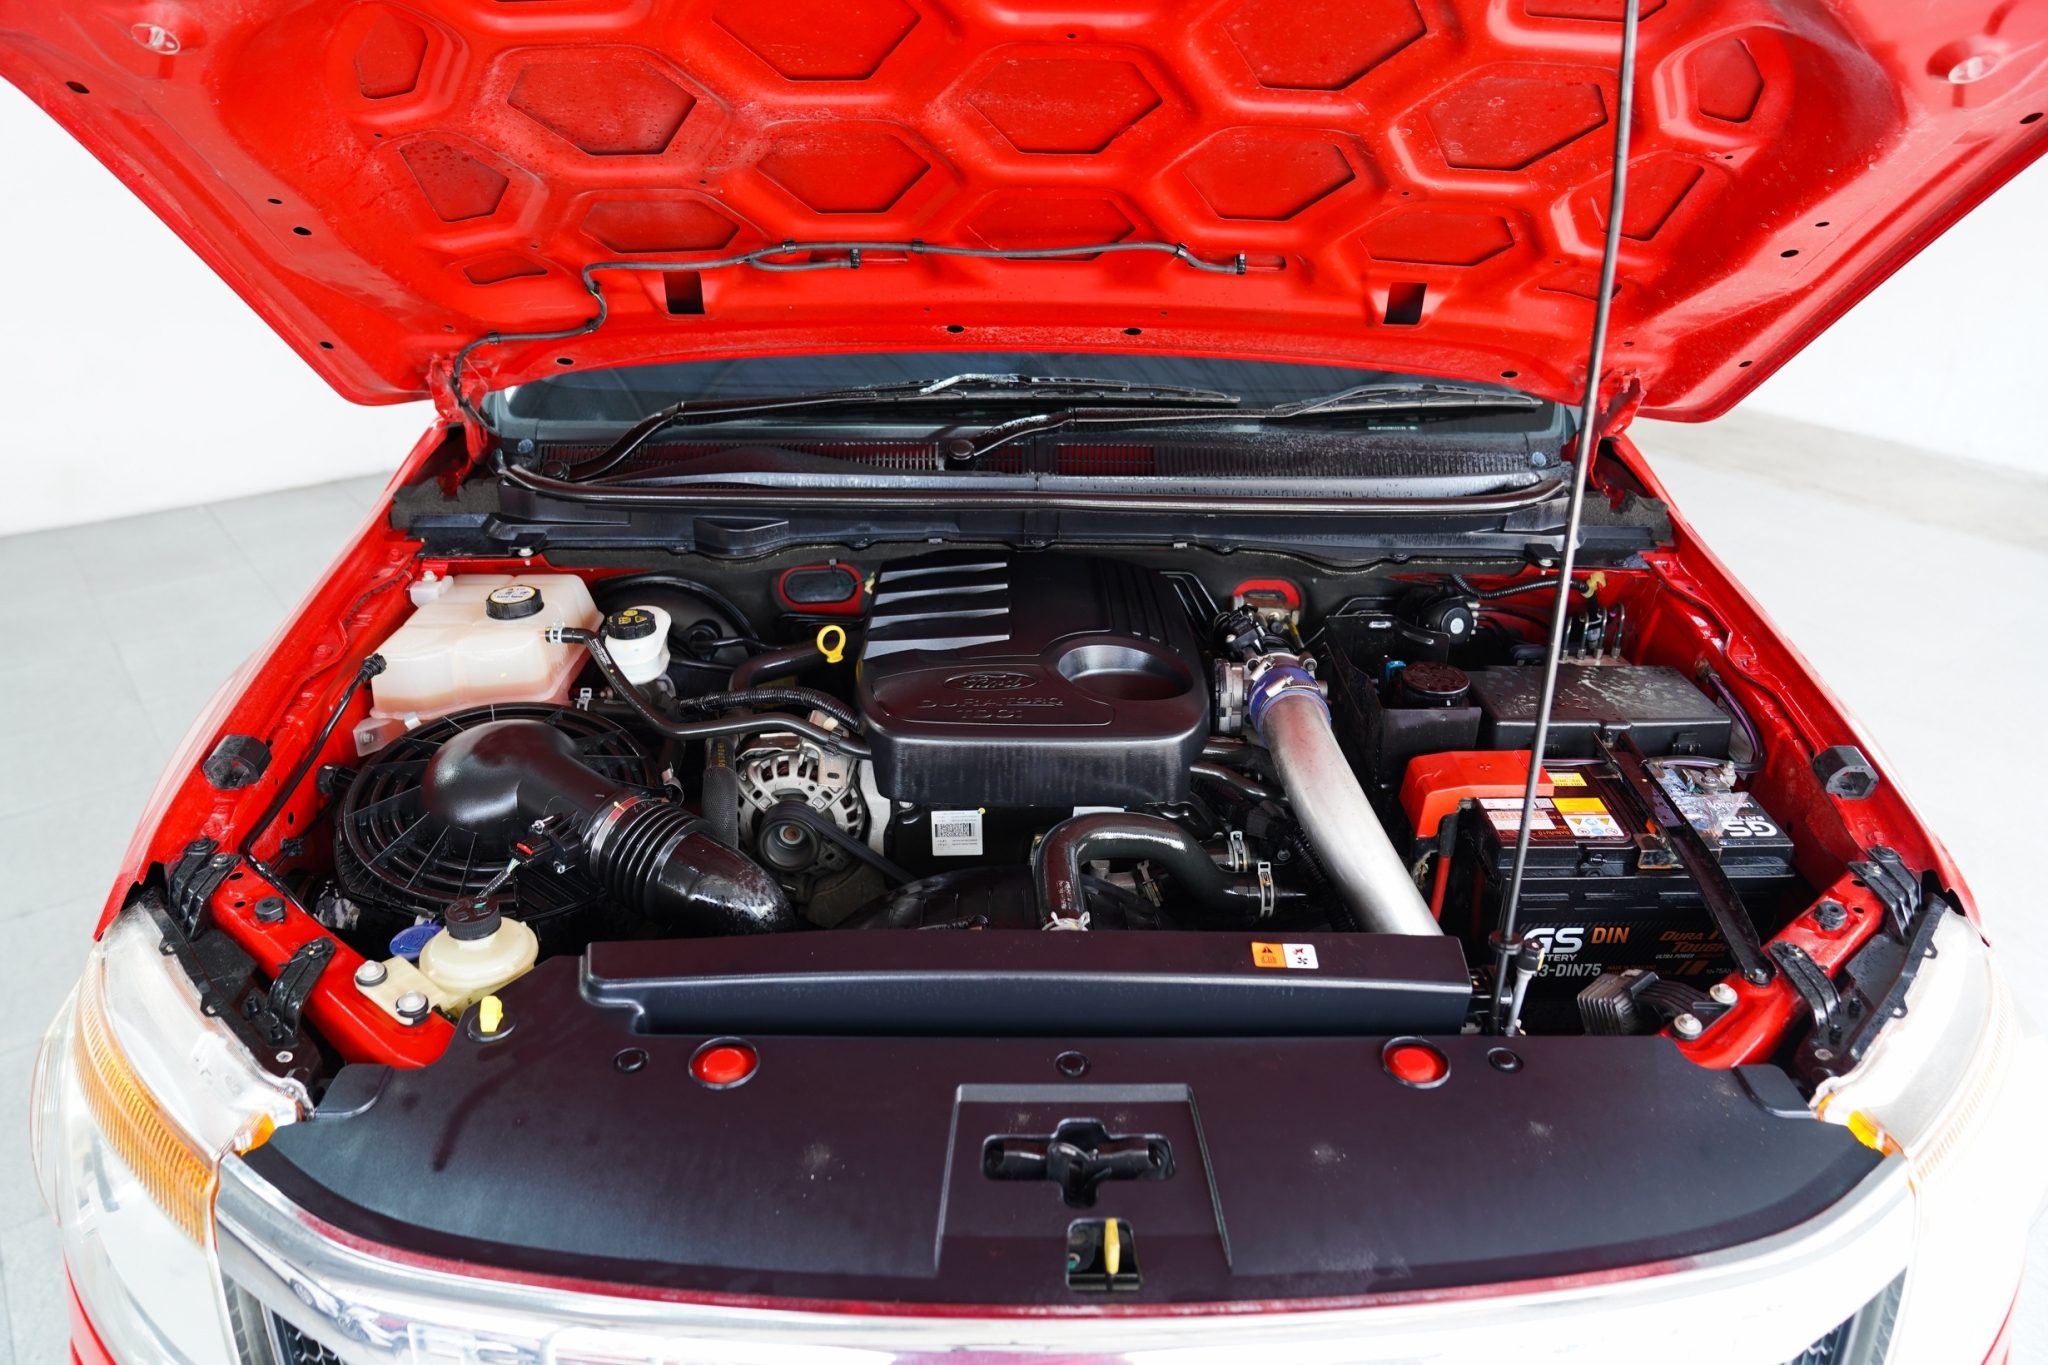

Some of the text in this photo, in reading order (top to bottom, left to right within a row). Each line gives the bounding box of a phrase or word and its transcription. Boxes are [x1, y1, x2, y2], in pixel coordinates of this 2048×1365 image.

[1721, 820, 1778, 837] GS
[1523, 927, 1585, 954] GS
[1591, 927, 1630, 944] DIN
[1660, 930, 1704, 941] DURA
